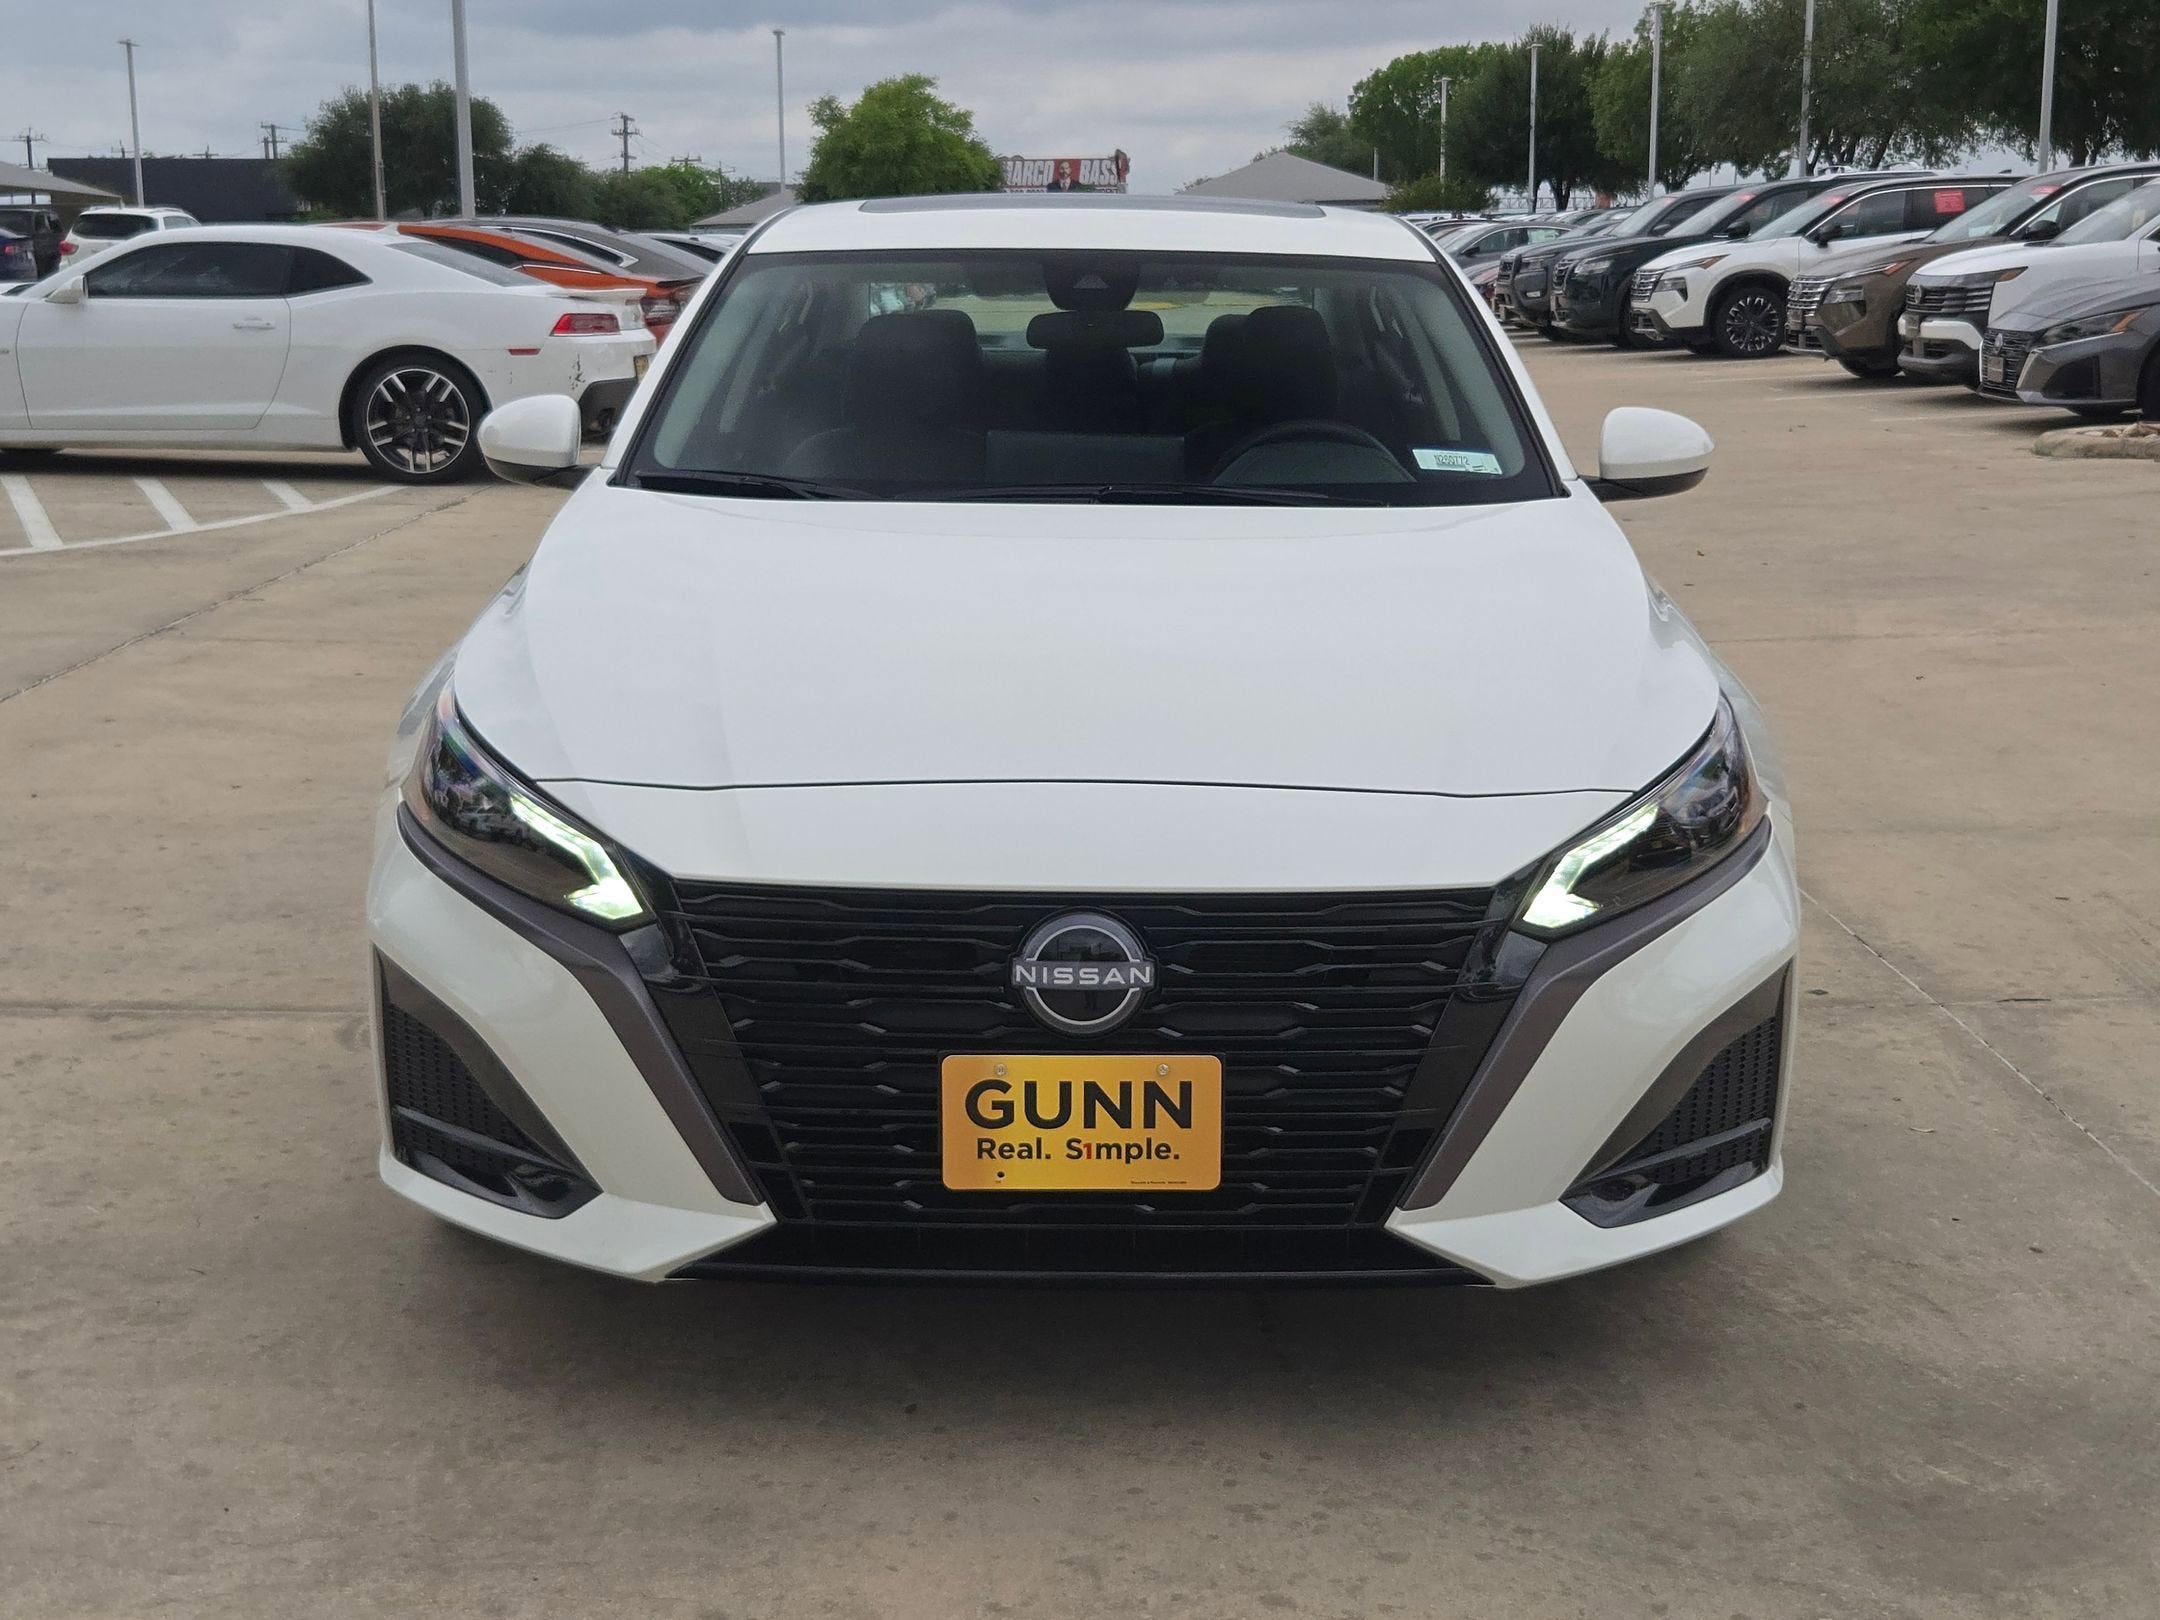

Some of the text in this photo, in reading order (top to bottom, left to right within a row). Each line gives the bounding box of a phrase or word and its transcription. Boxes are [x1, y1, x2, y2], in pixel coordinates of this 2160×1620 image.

[1015, 964, 1151, 985] NISSAN
[964, 1078, 1193, 1130] GUNN
[977, 1137, 1052, 1160] Real.
